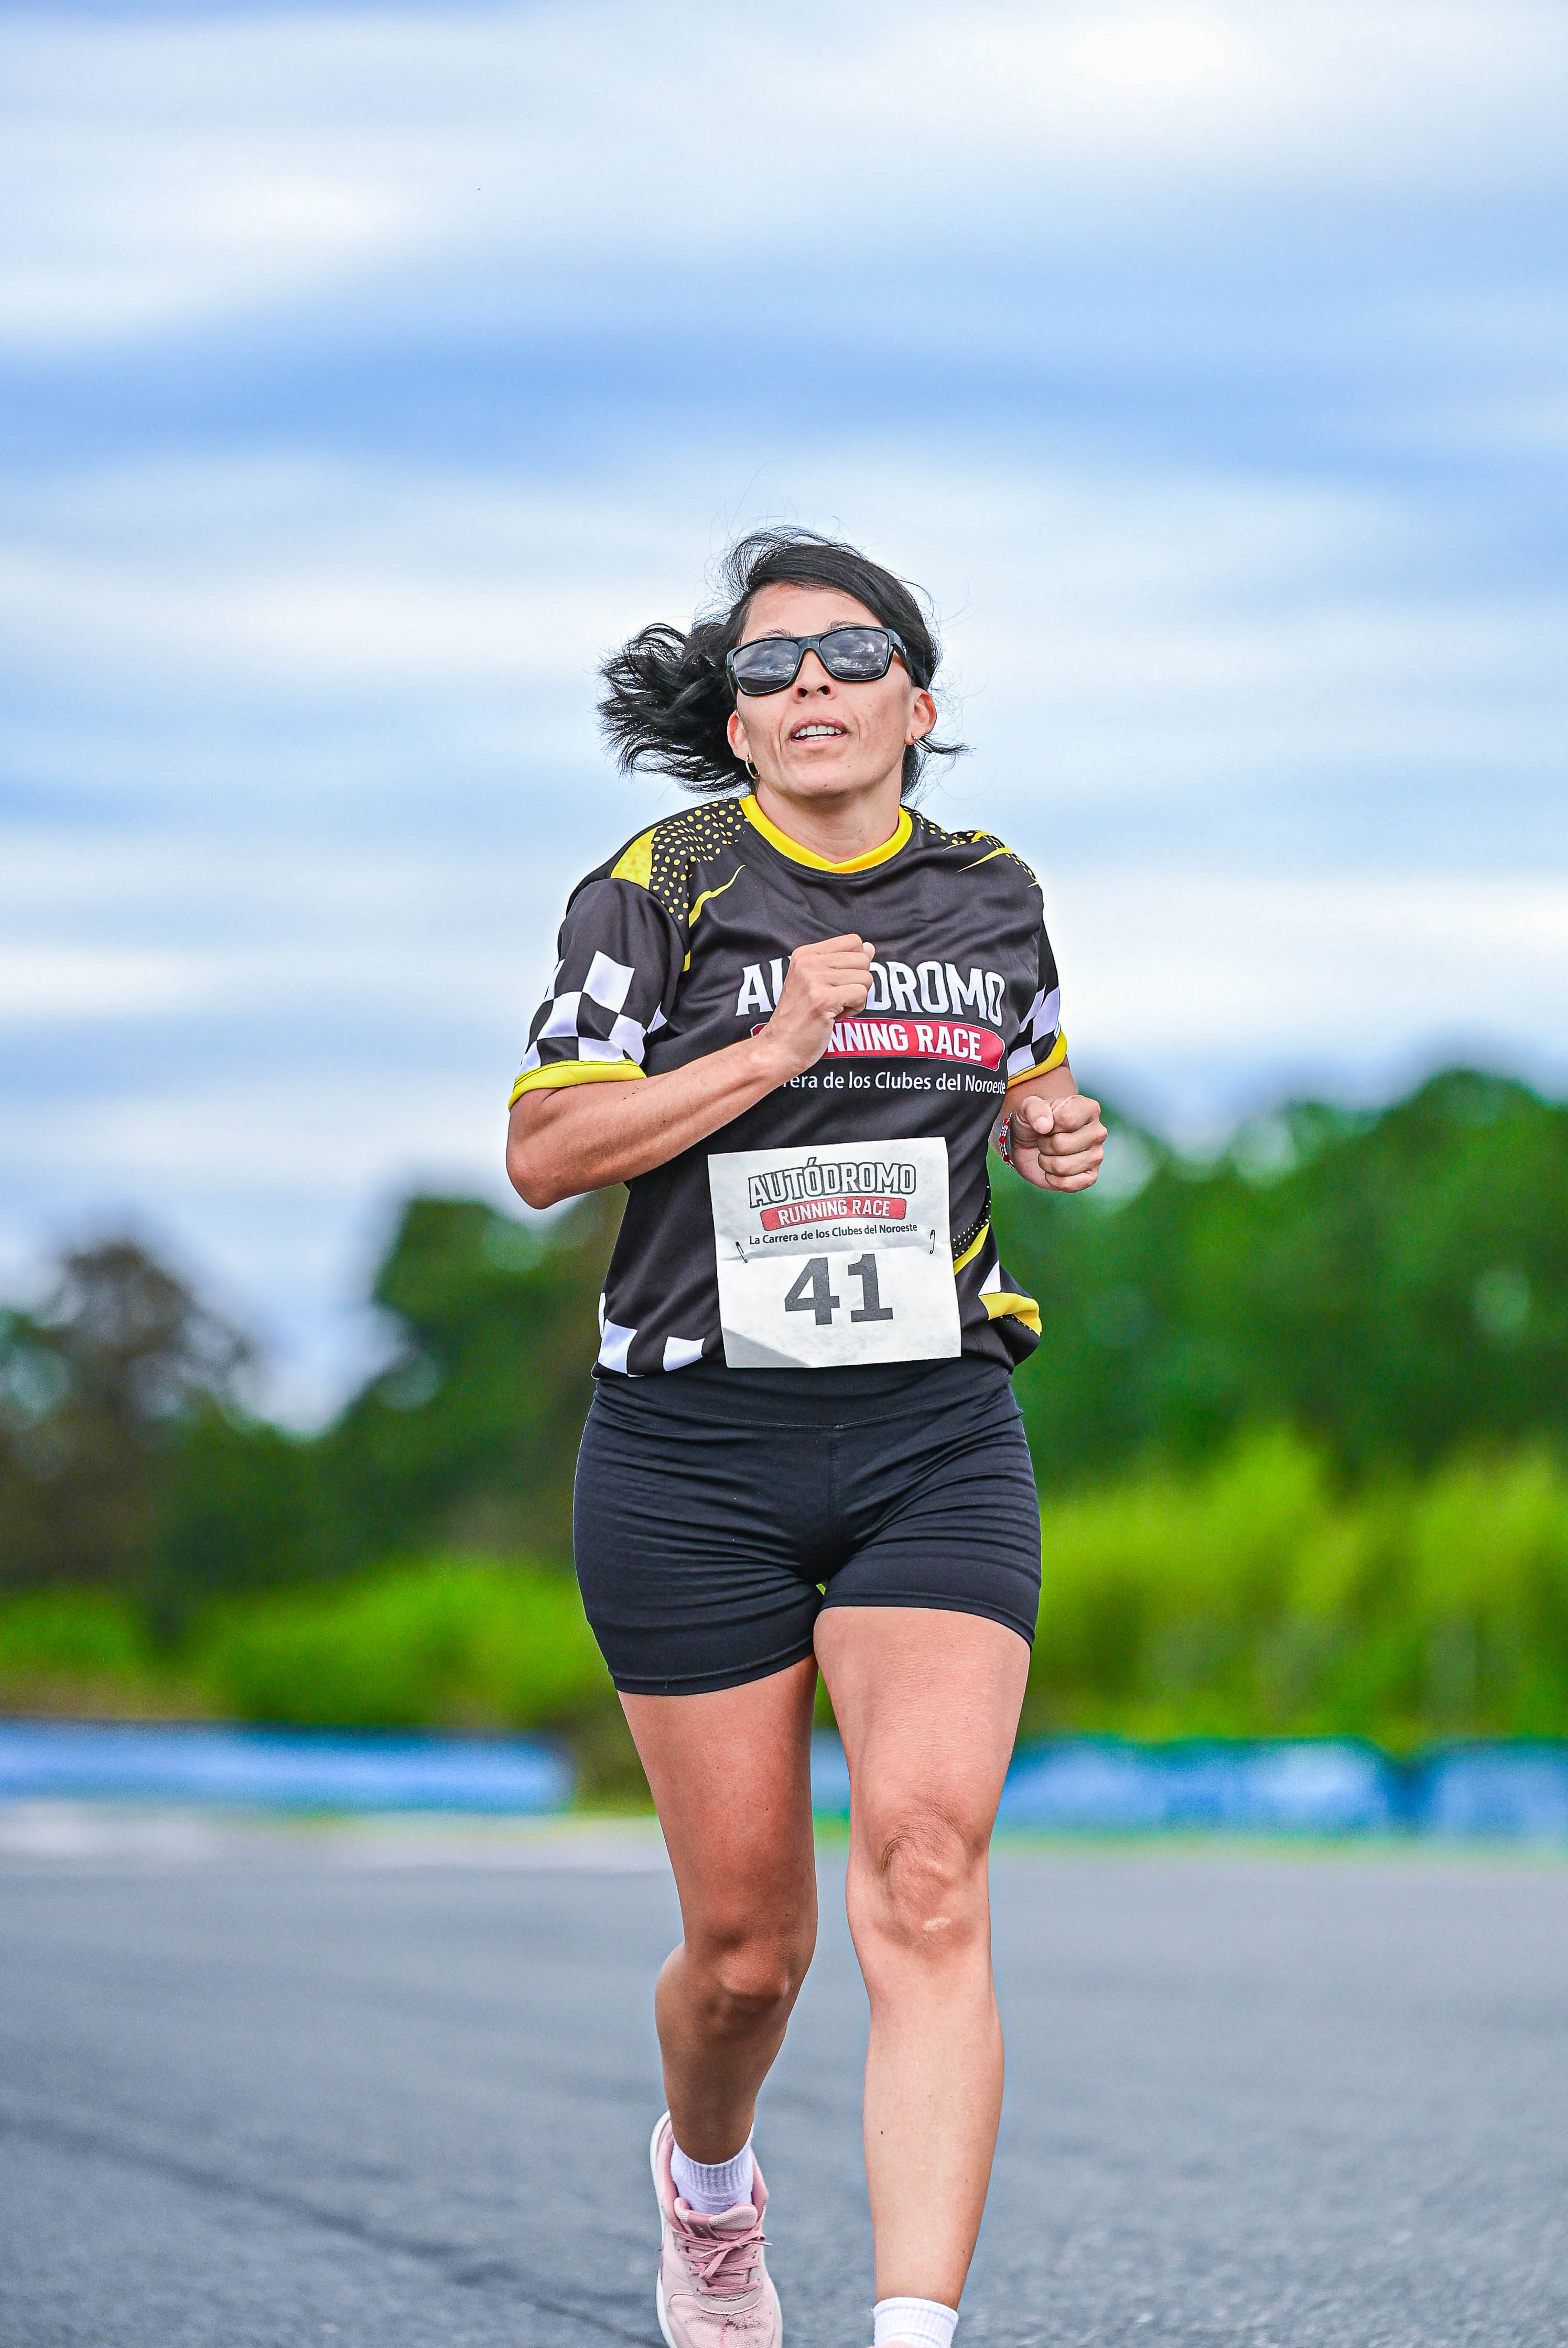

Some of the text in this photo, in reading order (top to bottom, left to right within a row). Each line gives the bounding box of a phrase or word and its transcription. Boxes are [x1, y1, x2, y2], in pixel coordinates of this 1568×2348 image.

[735, 955, 1005, 1027] ADROMO
[827, 1022, 982, 1062] NNING RACE
[823, 1071, 845, 1089] de
[849, 1071, 871, 1089] los
[874, 1071, 932, 1090] Clubes
[935, 1073, 961, 1091] del
[965, 1074, 1006, 1095] Noroeste
[748, 1157, 916, 1209] AUTÓDROMO
[777, 1199, 891, 1226] RUNNING RACE
[749, 1223, 917, 1245] La Carrera de los Clubes del Noroeste
[784, 1254, 894, 1326] 41
